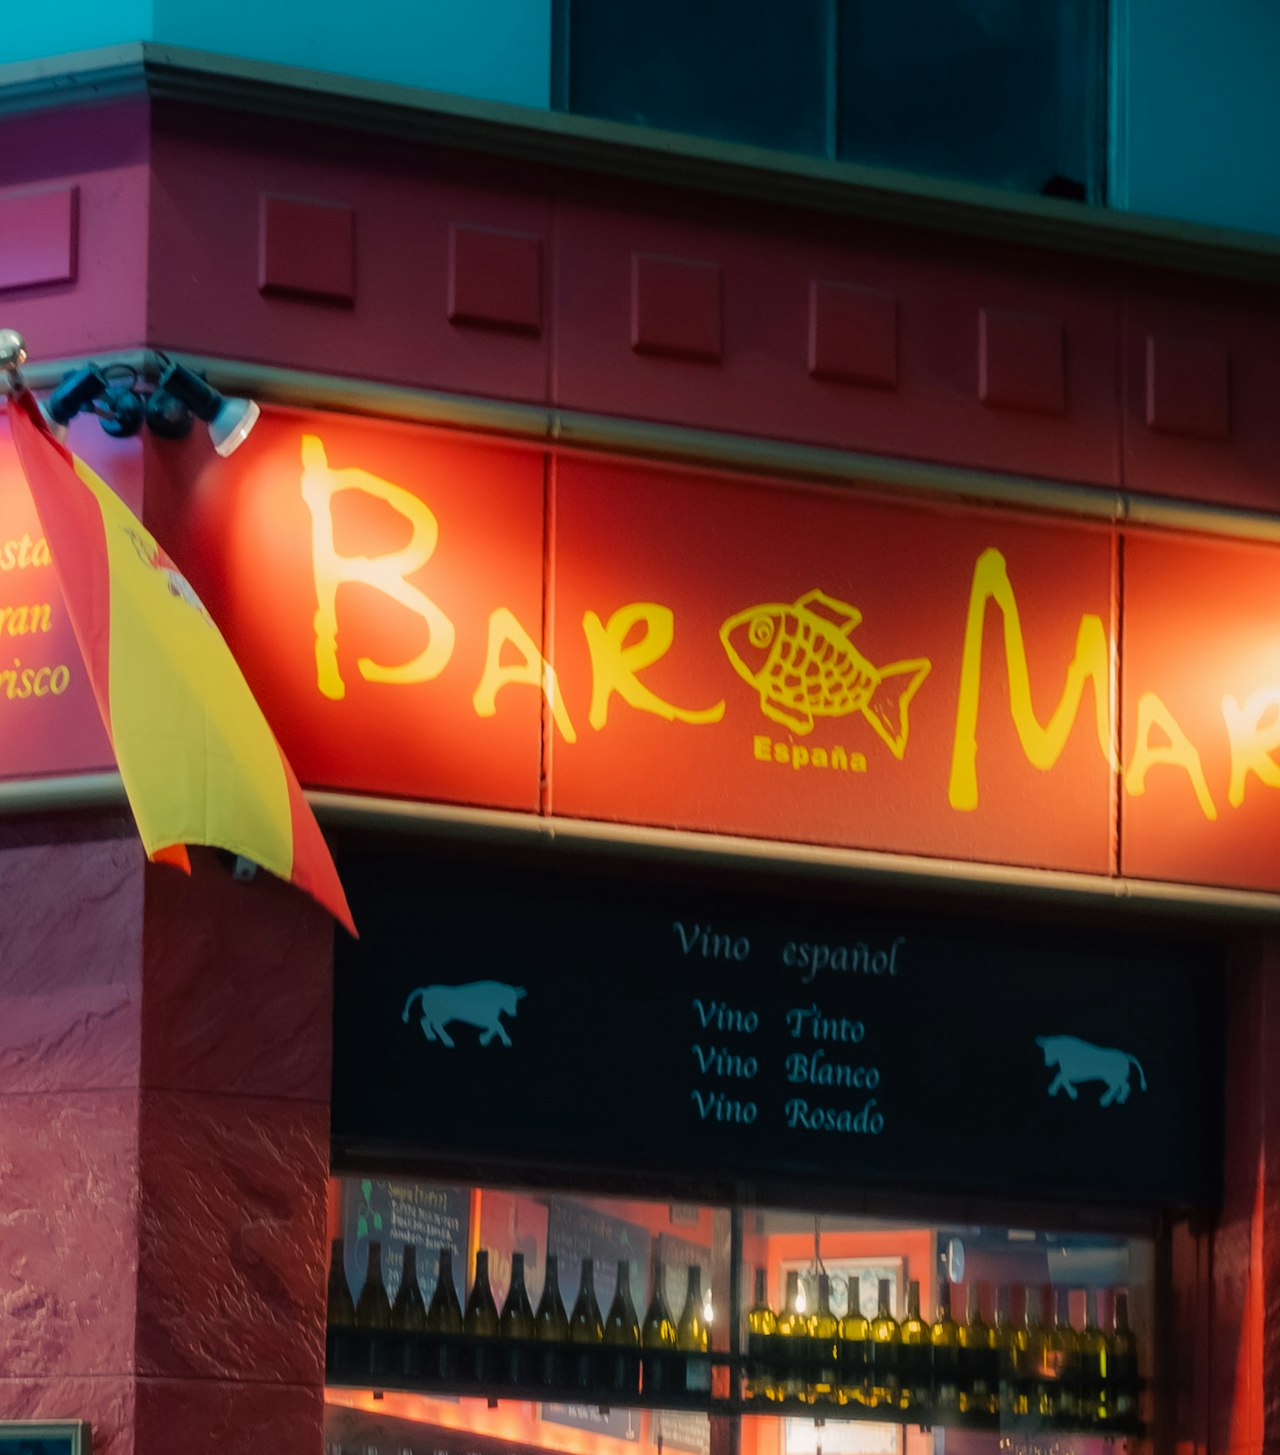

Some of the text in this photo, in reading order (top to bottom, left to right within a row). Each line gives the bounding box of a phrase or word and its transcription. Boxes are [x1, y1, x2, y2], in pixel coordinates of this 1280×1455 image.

[753, 734, 868, 774] España
[673, 920, 907, 984] Vino español
[691, 998, 866, 1043] Vino Tinto
[690, 1043, 880, 1089] Vino Blanco
[690, 1089, 884, 1135] Vino Rosado
